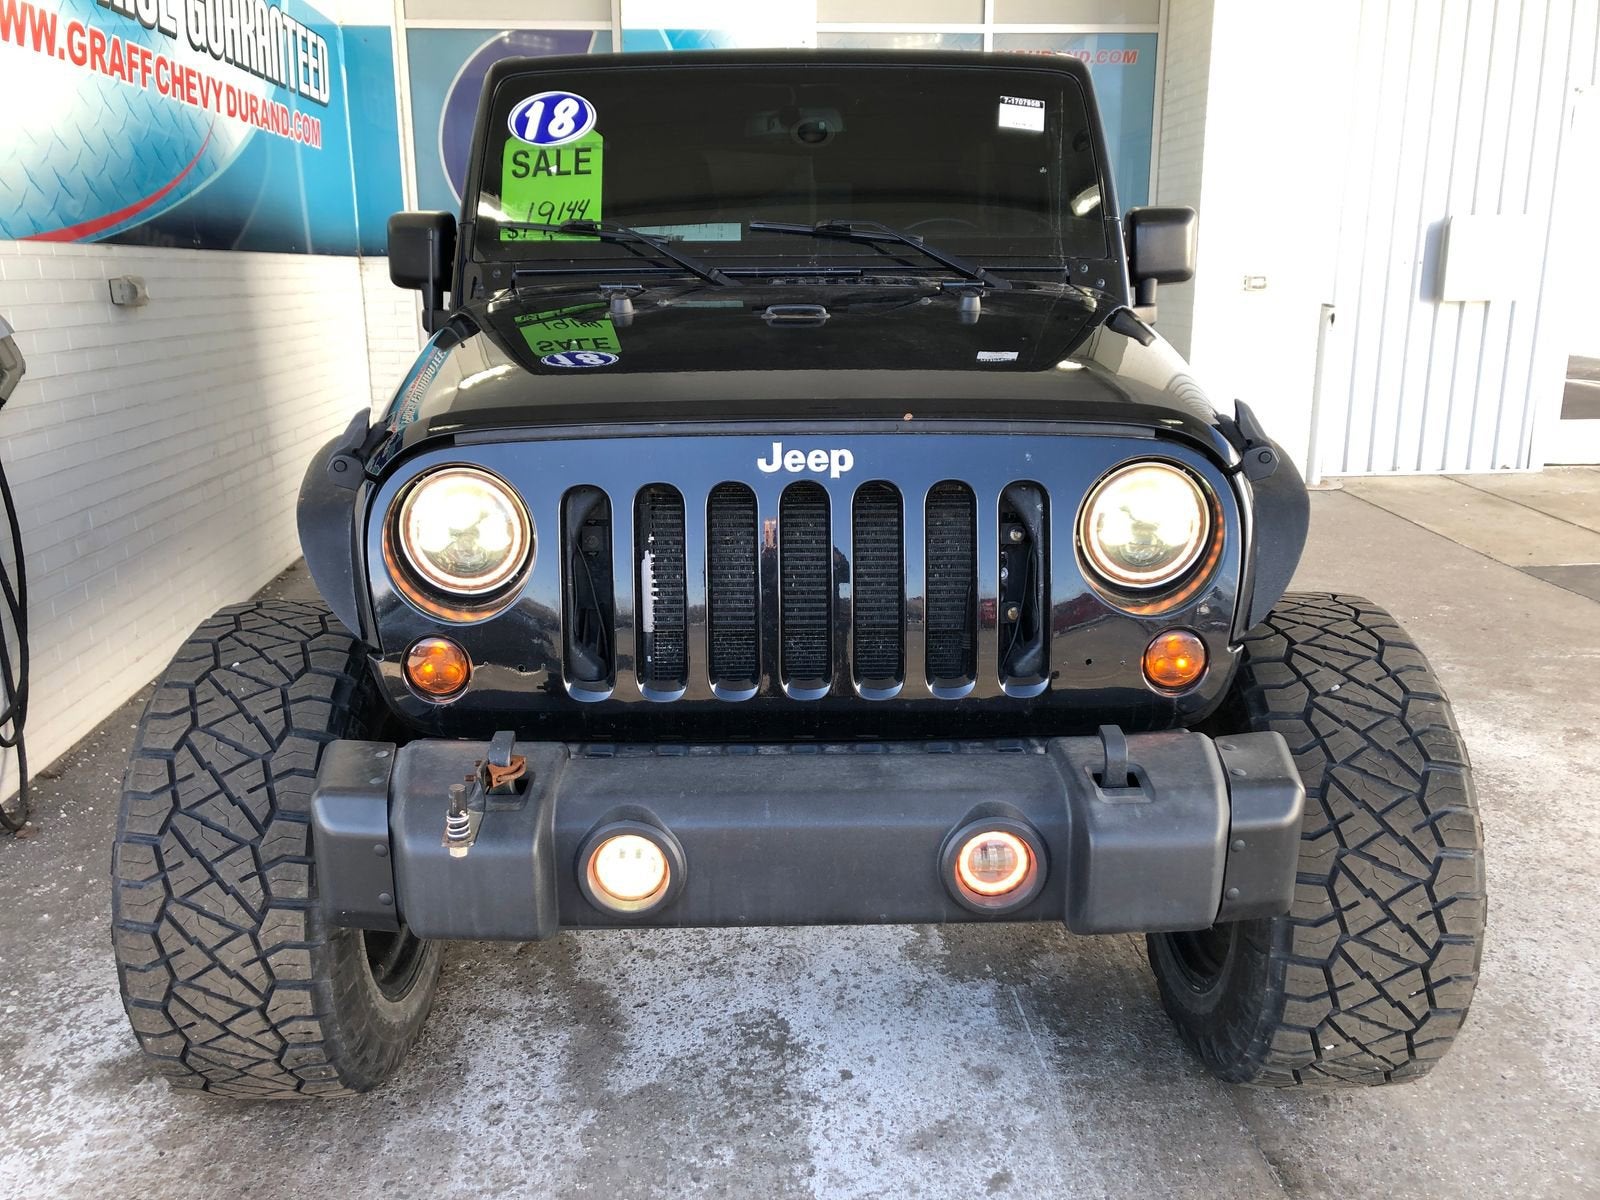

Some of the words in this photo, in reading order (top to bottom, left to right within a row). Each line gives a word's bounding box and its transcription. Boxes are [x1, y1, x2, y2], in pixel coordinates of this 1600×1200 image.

[185, 0, 329, 107] GUARANTEED
[524, 97, 580, 141] 18
[511, 147, 592, 178] SALE
[526, 199, 591, 225] 19144
[757, 441, 854, 478] Jeep
